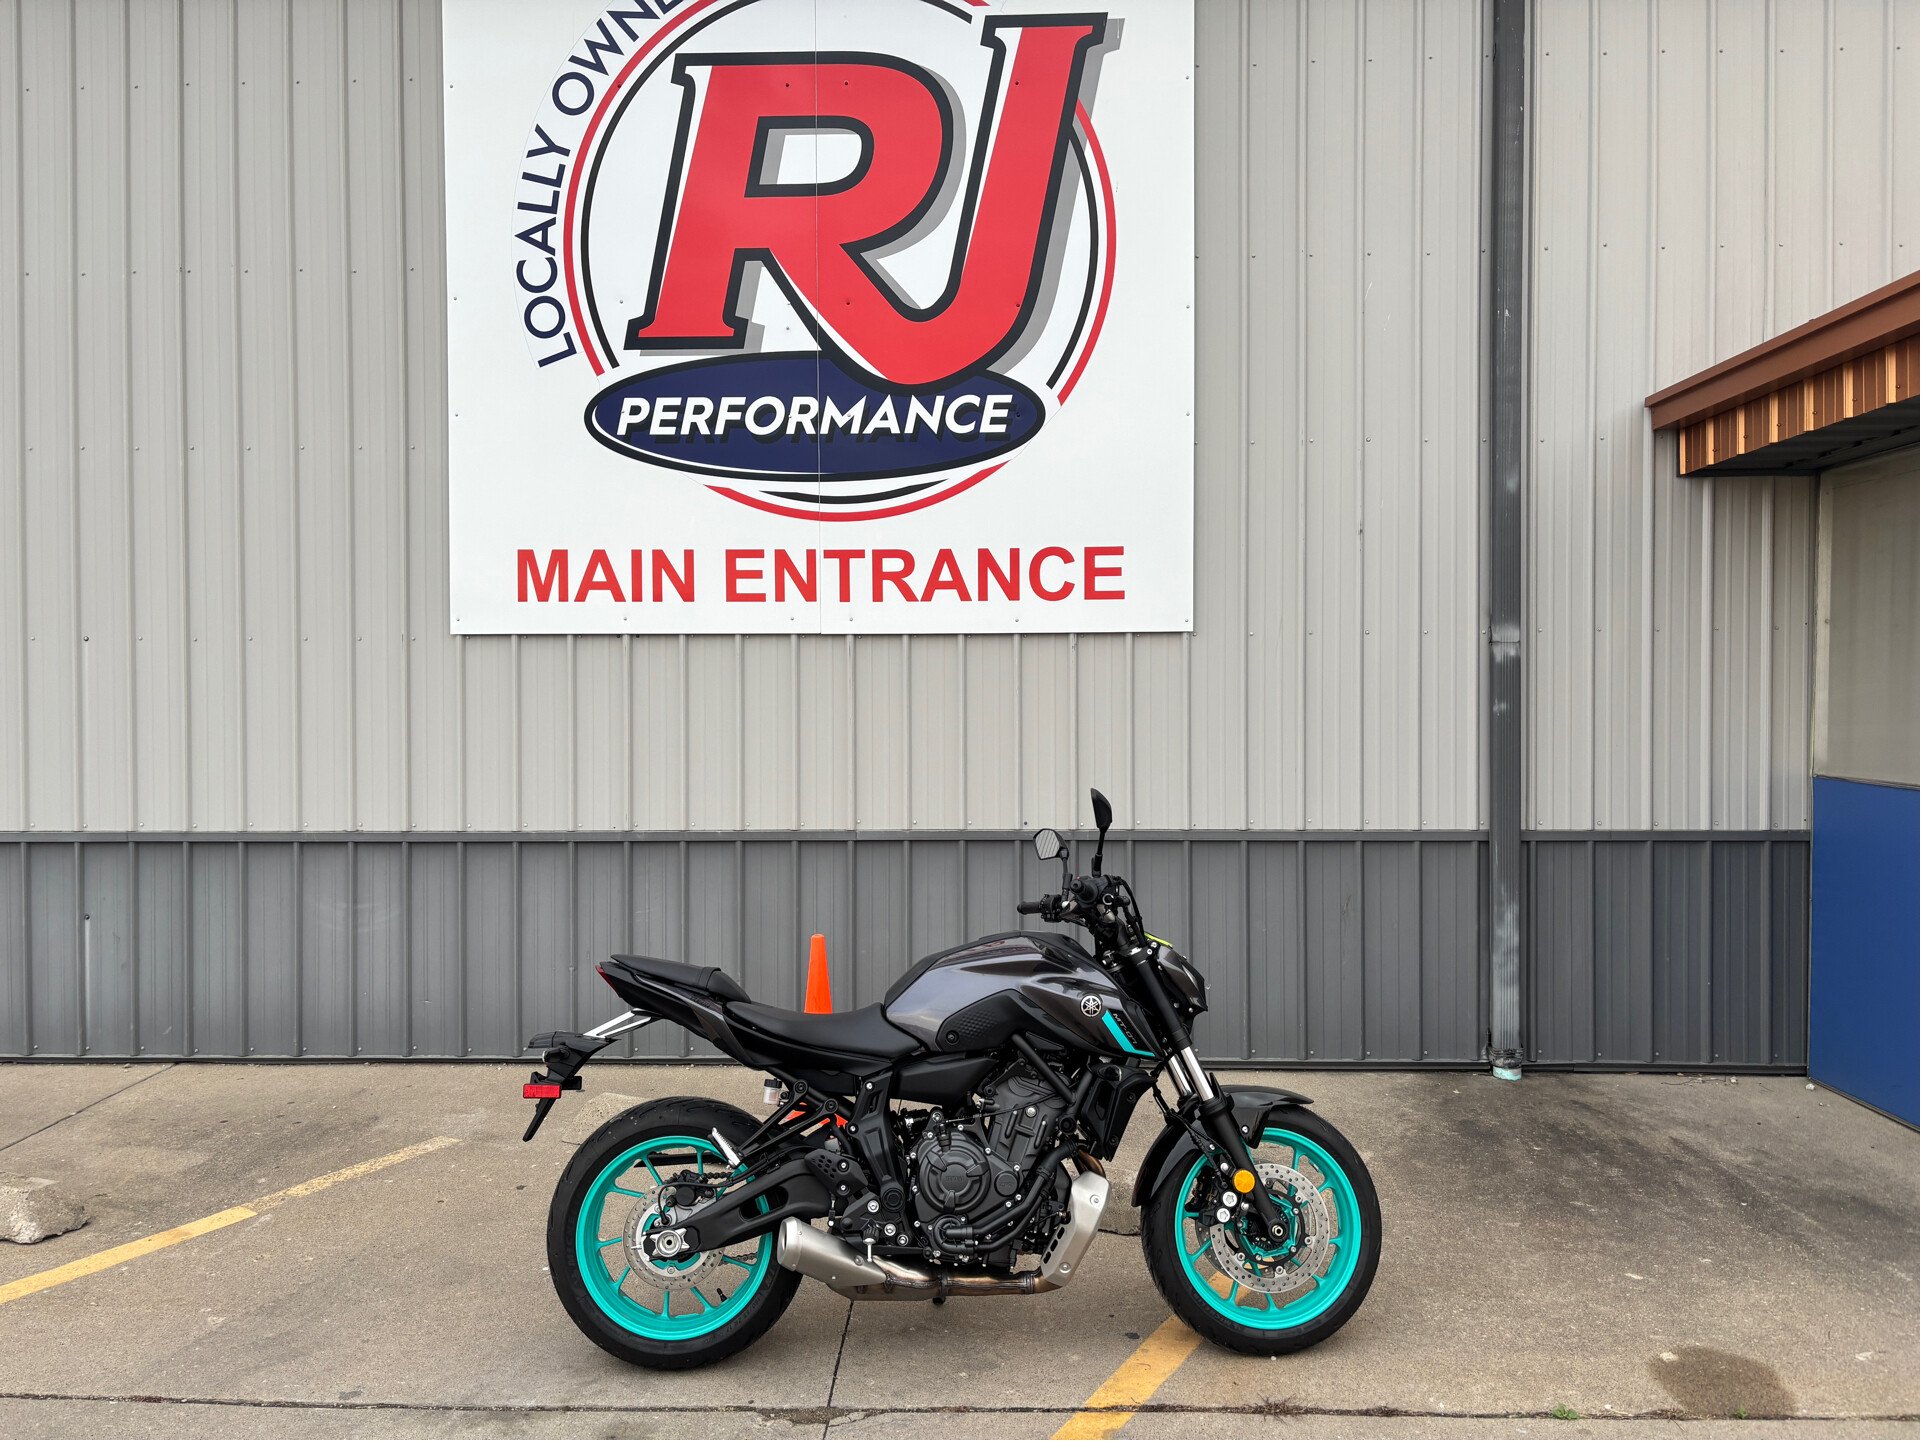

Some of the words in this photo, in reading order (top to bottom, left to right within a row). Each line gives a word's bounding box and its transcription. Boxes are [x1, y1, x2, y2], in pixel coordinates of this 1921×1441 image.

[515, 123, 577, 368] LOCALLY
[624, 12, 1110, 393] RJ
[616, 393, 1014, 438] PERFORMANCE
[516, 549, 695, 603] MAIN
[726, 545, 1126, 603] ENTRANCE
